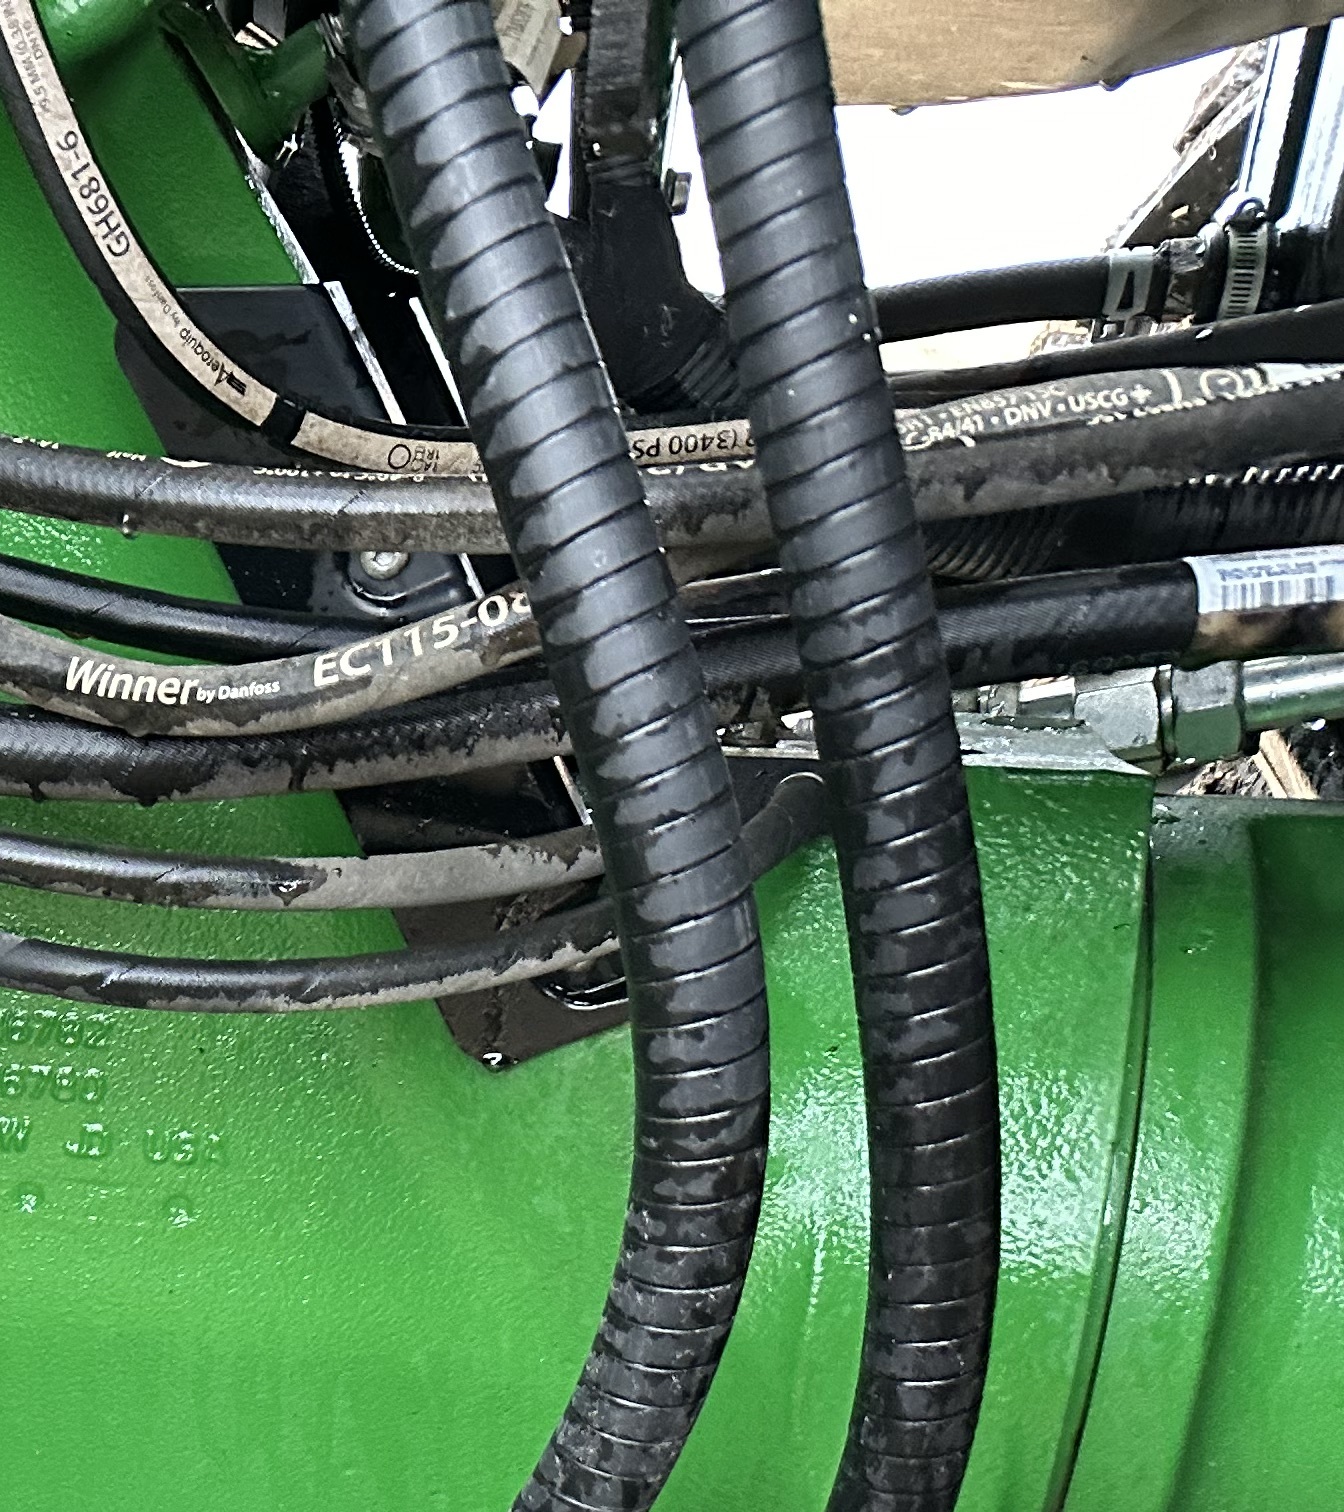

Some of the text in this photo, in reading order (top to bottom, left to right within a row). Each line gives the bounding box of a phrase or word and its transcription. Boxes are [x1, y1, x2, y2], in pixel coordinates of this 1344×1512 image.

[56, 130, 131, 258] GH681-6
[179, 326, 233, 387] Aeroquip
[1003, 400, 1052, 426] DNV
[632, 437, 660, 460] PS
[64, 655, 199, 706] Winner
[195, 684, 216, 704] by
[218, 679, 281, 699] Danfoss
[63, 1121, 109, 1158] JD
[143, 1127, 226, 1165] USA
